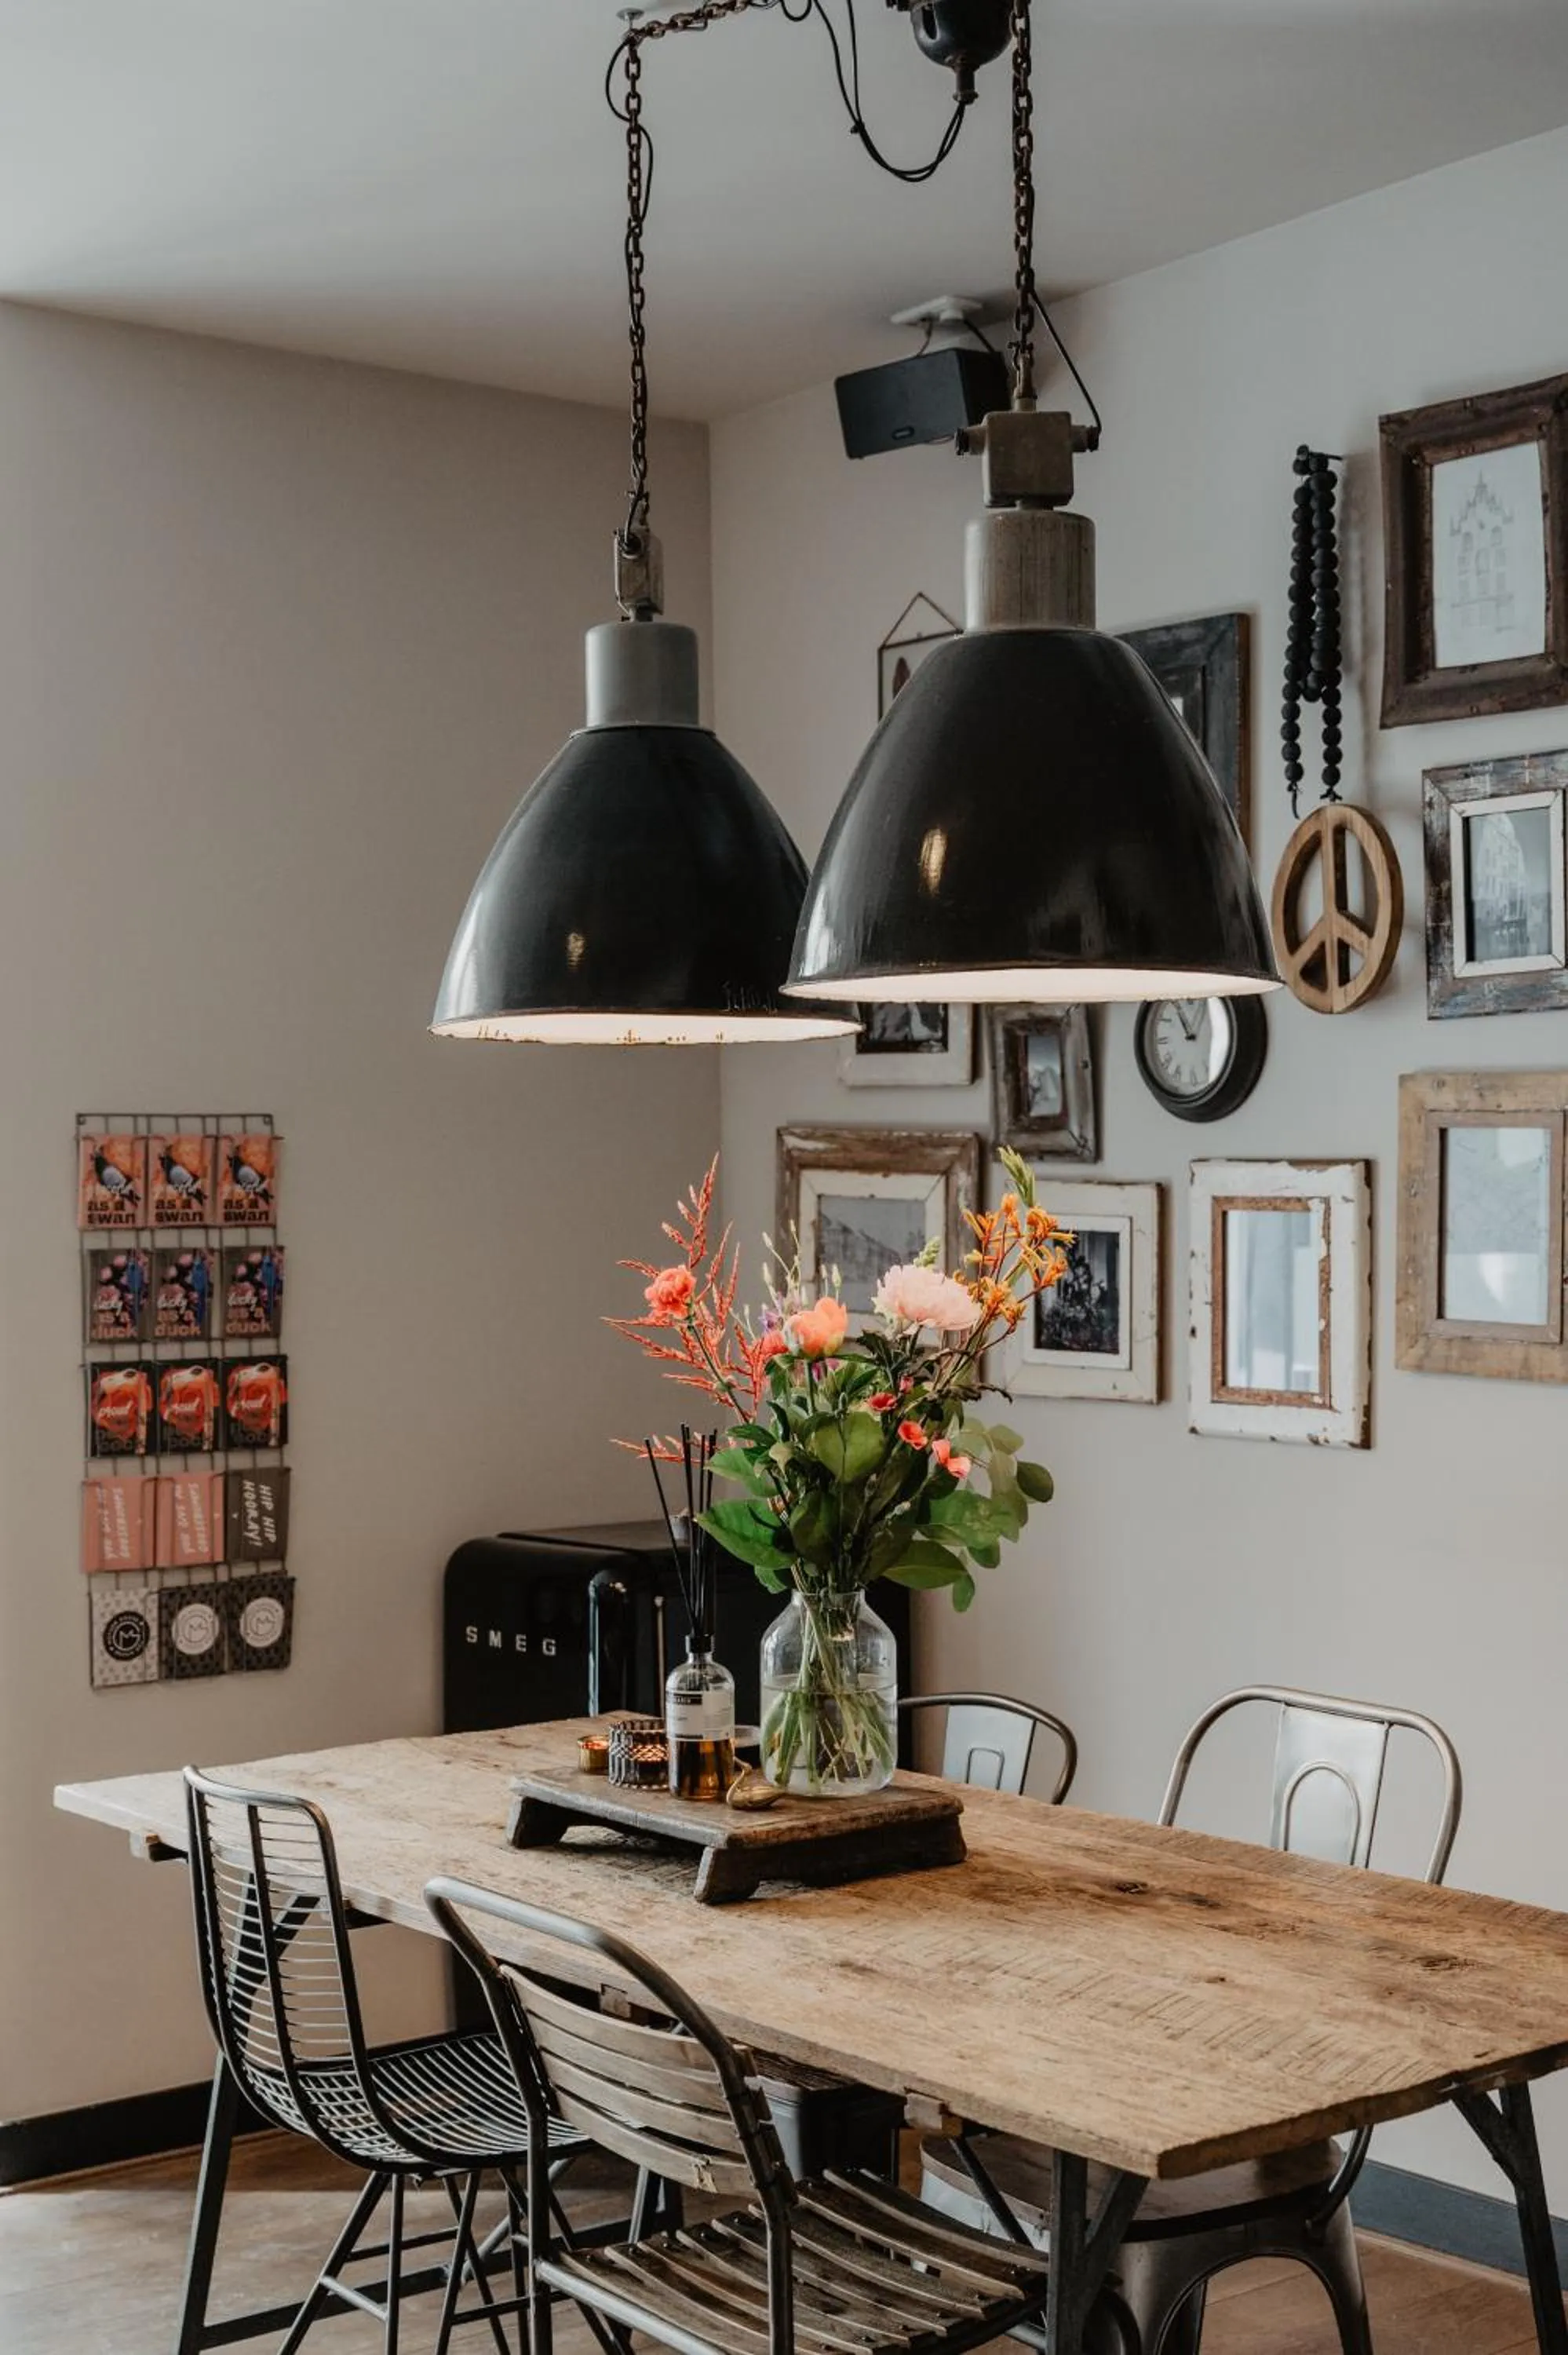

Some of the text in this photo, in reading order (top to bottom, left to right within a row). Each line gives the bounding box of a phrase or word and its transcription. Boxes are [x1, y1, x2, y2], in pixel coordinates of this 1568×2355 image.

[112, 1199, 126, 1212] a
[155, 1198, 193, 1210] as a
[247, 1197, 260, 1210] a
[87, 1212, 137, 1225] swan
[155, 1210, 204, 1223] swan
[223, 1210, 270, 1222] swan
[154, 1323, 202, 1337] duck
[225, 1320, 272, 1334] duck
[242, 1479, 264, 1547] HOORAY!
[258, 1484, 277, 1543] HIP HIP
[465, 1624, 557, 1657] SMEG
